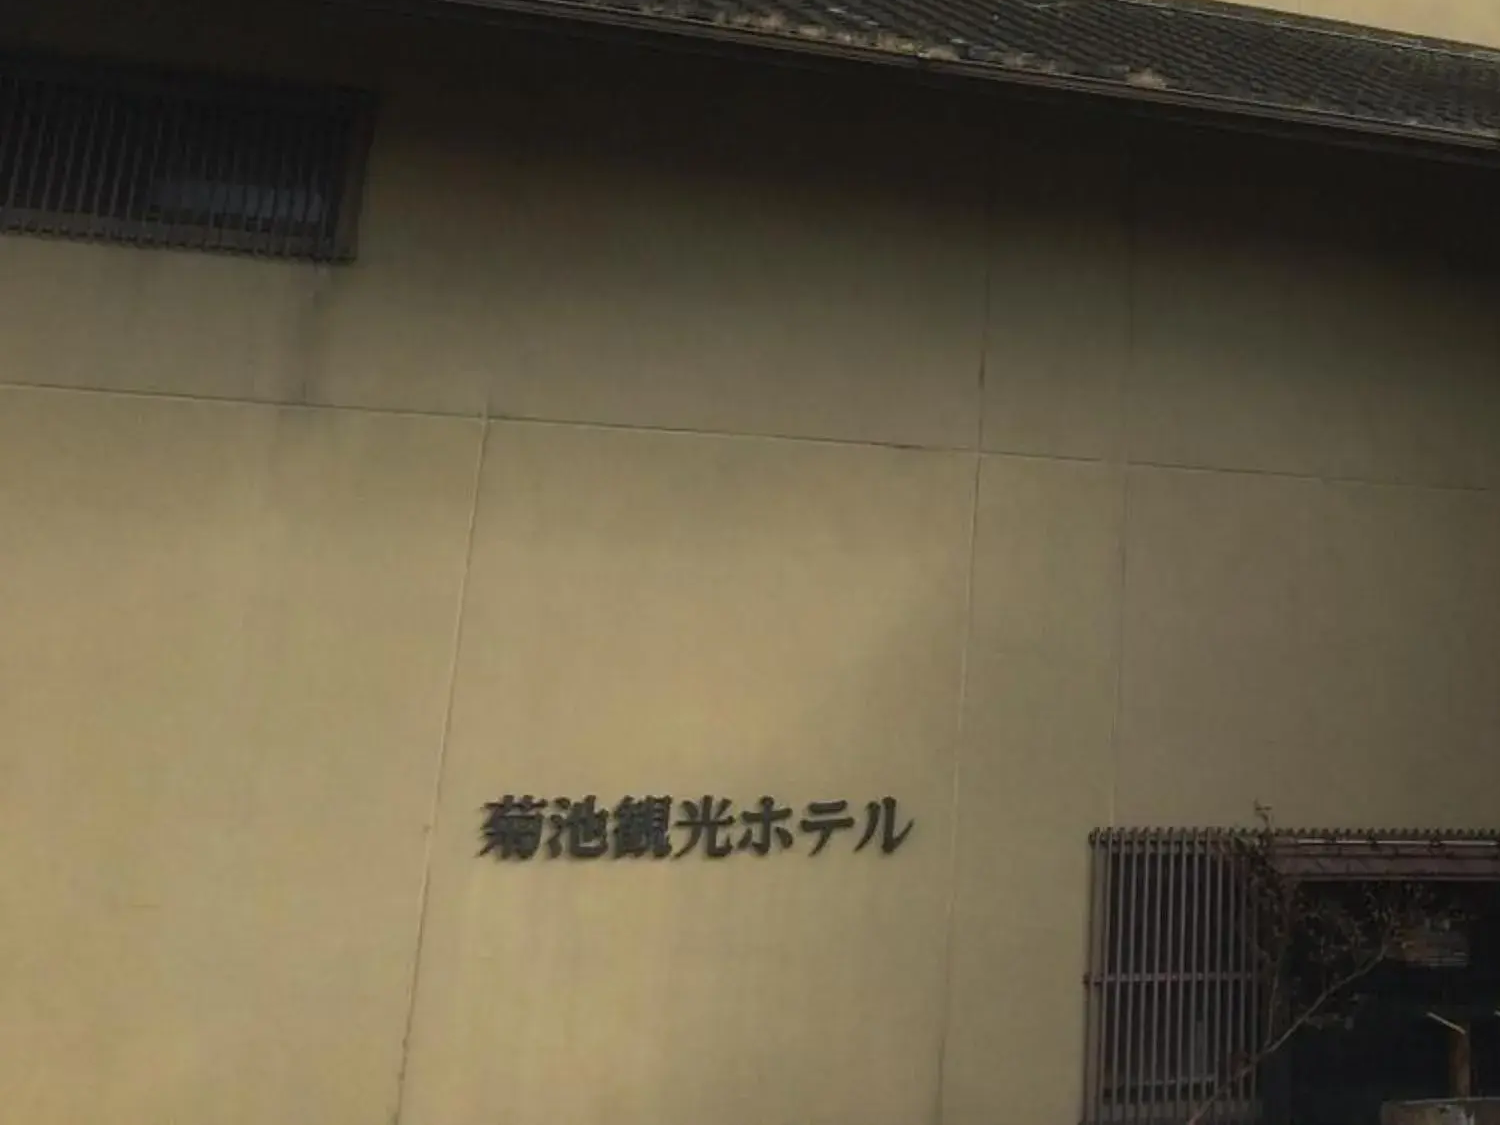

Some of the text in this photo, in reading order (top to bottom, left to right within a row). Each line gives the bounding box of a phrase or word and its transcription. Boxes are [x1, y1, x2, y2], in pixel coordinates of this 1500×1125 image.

[480, 794, 913, 859] 菊池観光ホテル
